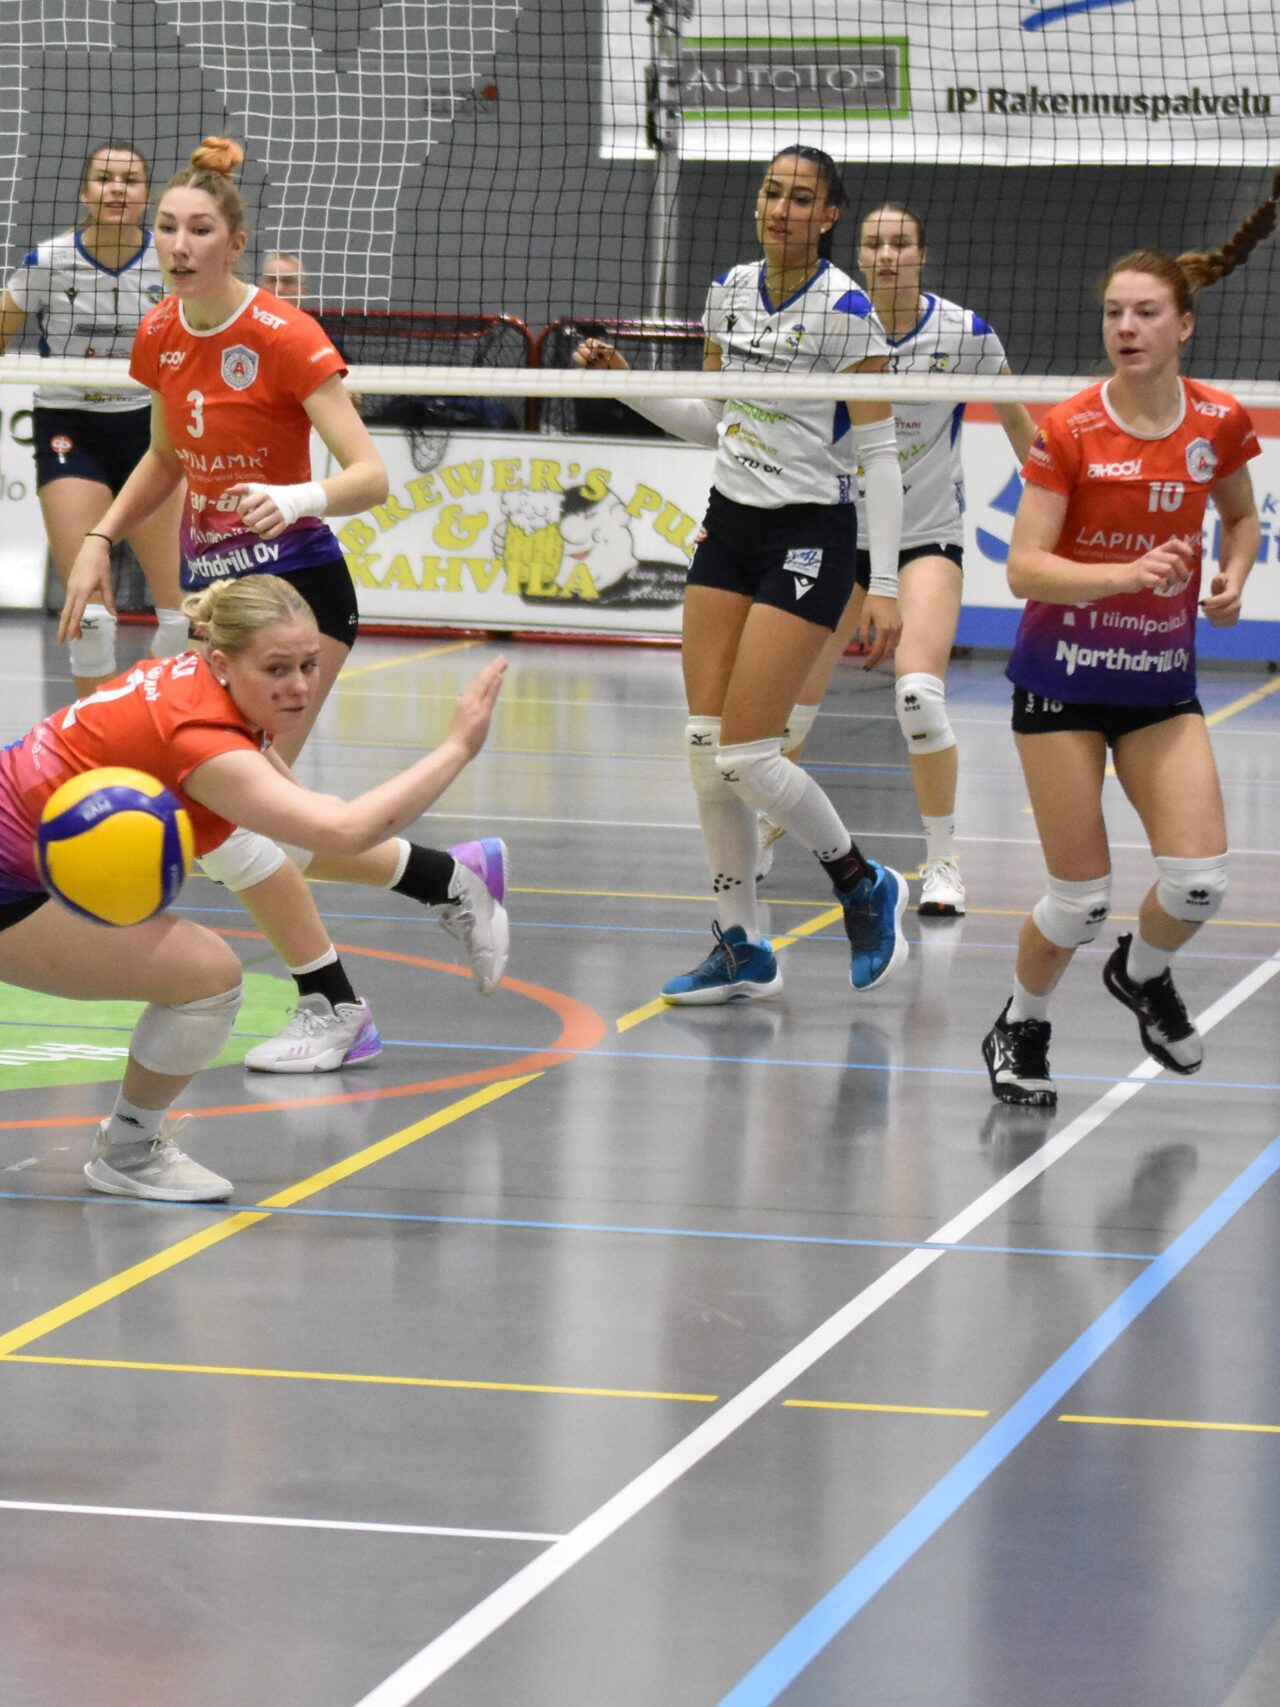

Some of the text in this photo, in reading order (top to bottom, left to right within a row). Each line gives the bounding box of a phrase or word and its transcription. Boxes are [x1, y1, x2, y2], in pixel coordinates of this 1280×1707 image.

[685, 64, 885, 93] AUTOTOP
[947, 85, 1272, 121] IP Rakennuspalvelu
[186, 390, 204, 438] 3
[1148, 481, 1184, 512] 10
[253, 542, 279, 563] Oy
[1076, 526, 1156, 551] LAPIN
[345, 551, 600, 599] KAHVILA
[1055, 639, 1173, 676] Northdrill
